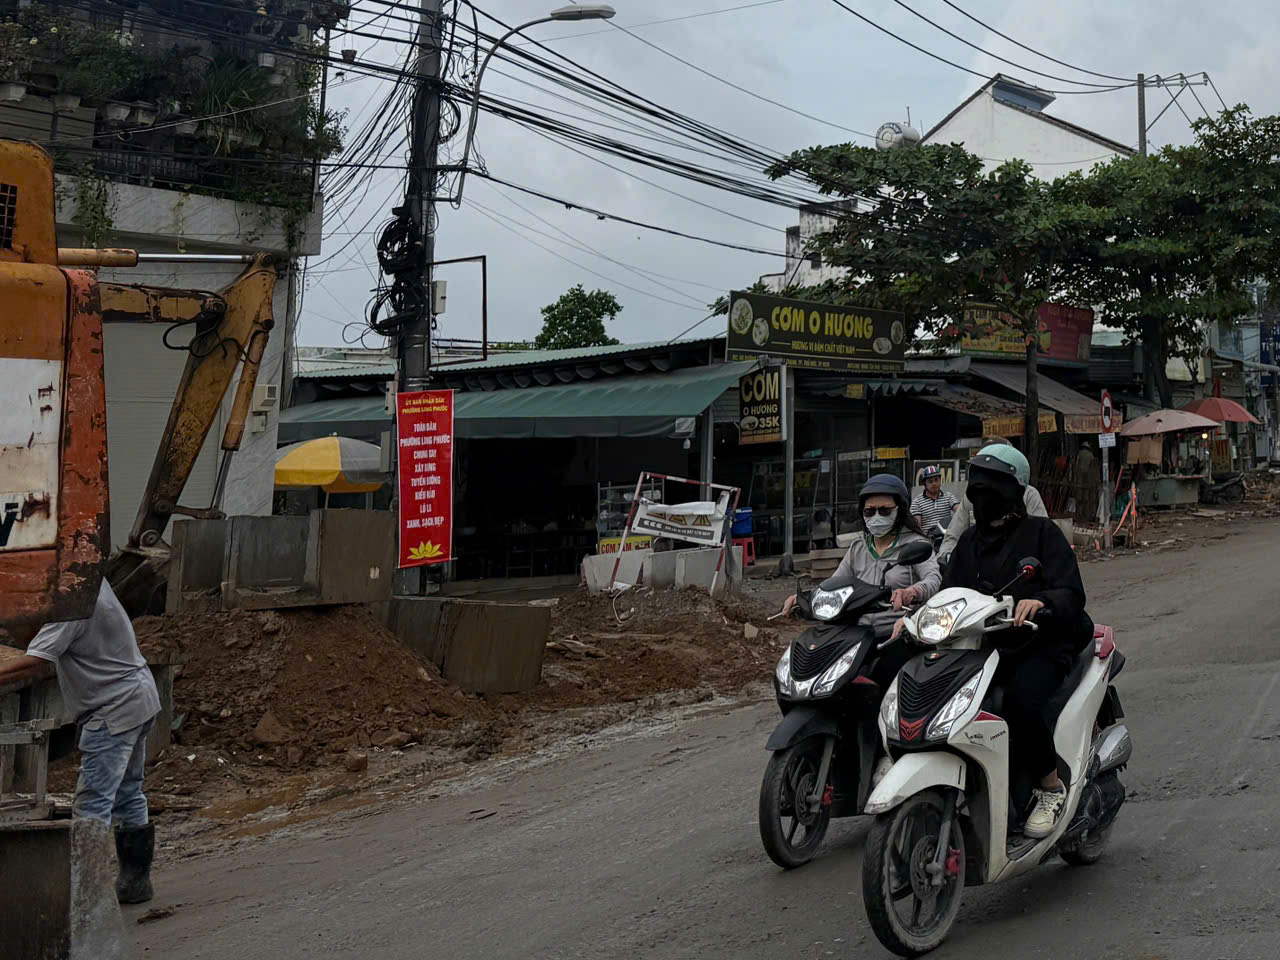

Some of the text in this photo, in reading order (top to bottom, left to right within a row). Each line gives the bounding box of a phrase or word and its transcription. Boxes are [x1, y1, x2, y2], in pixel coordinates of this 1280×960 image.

[771, 306, 873, 340] CƠM O HƯƠNG
[741, 368, 780, 403] CƠM
[743, 403, 779, 416] O HƯƠNG
[759, 416, 781, 429] 35K
